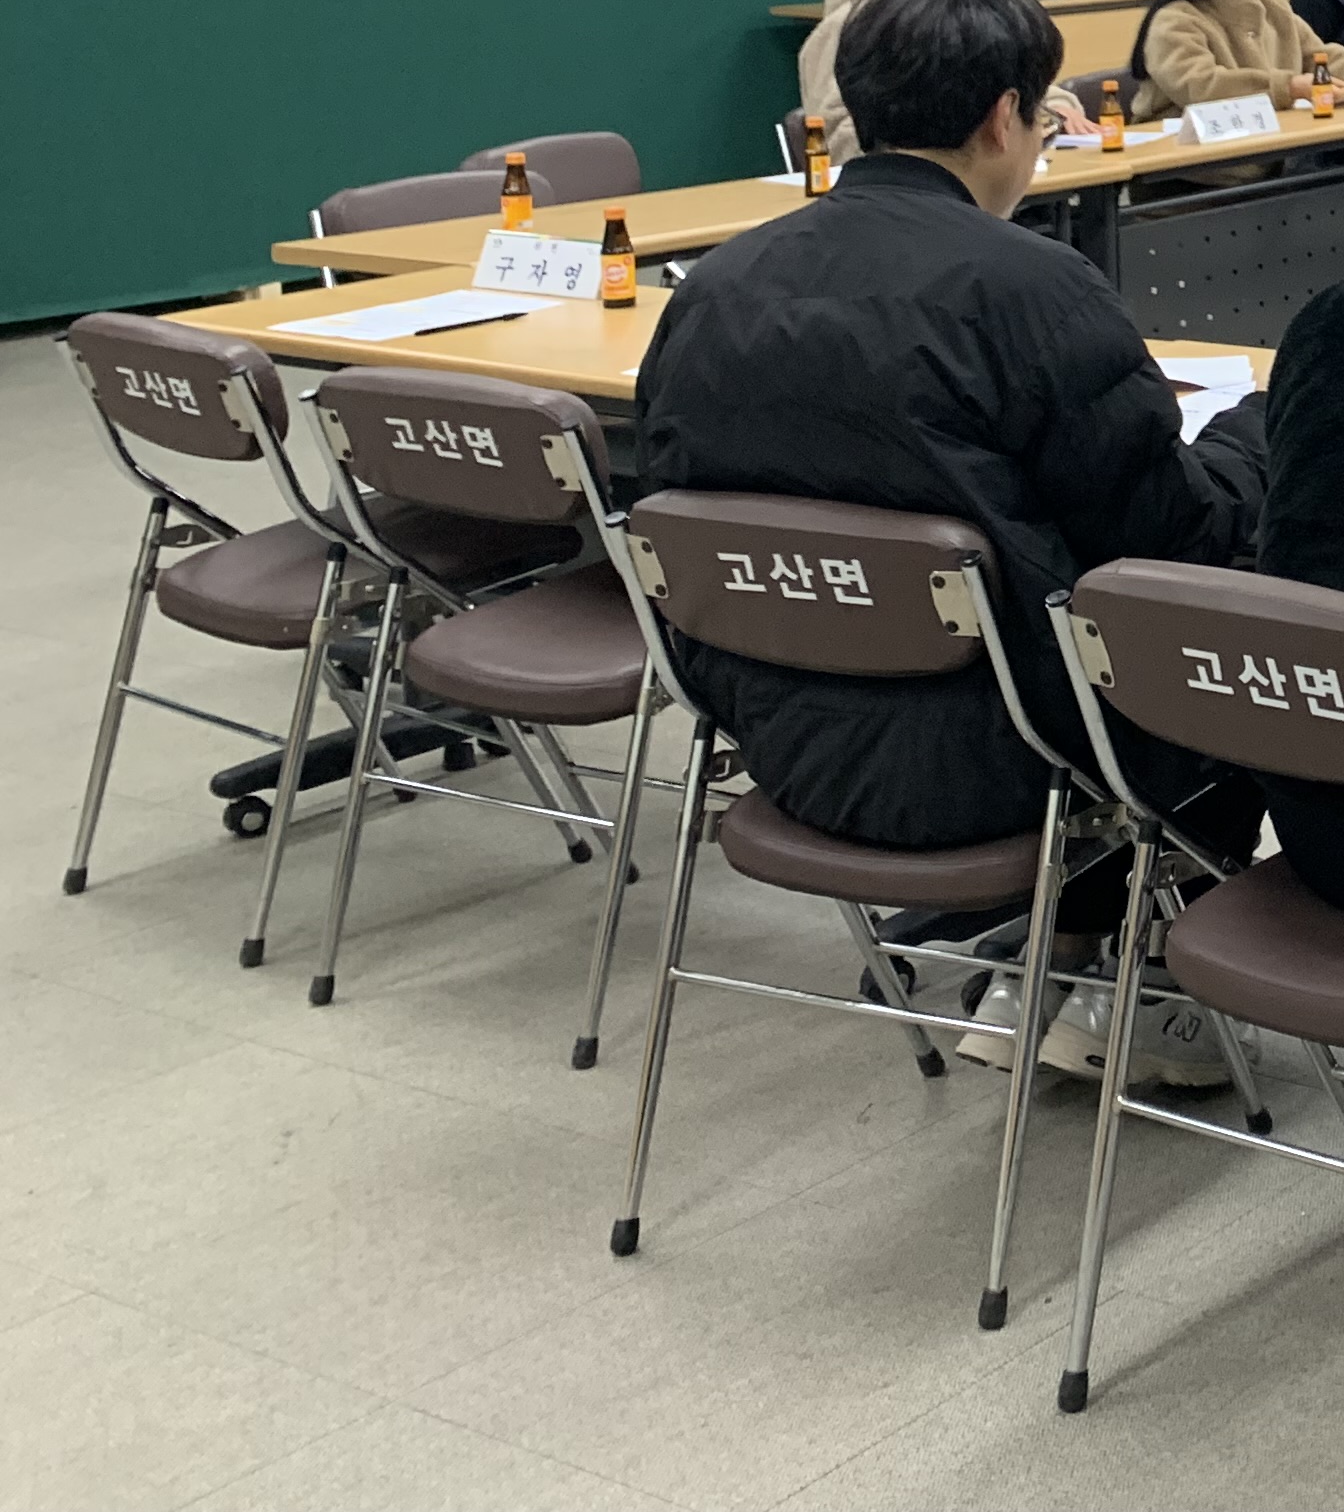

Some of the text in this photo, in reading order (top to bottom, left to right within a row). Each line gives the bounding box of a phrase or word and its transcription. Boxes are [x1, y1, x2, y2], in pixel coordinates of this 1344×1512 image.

[114, 365, 201, 417] 고산면
[384, 416, 504, 468] 고산면
[715, 551, 875, 607] 고산면
